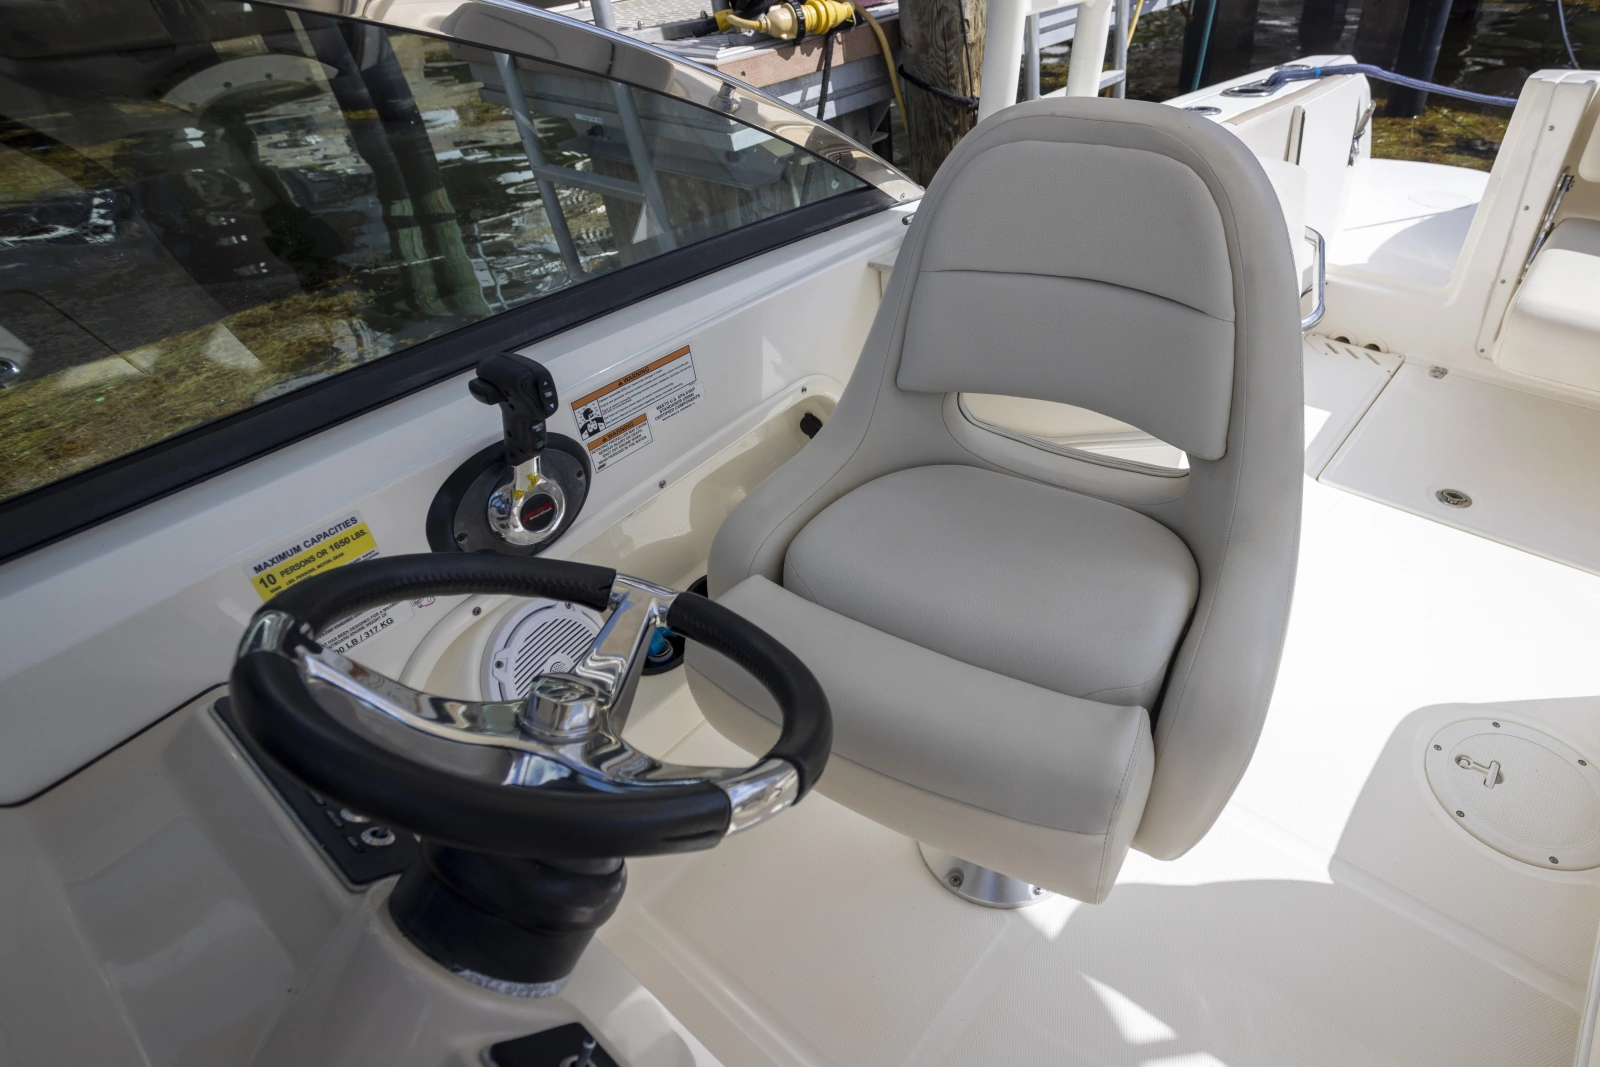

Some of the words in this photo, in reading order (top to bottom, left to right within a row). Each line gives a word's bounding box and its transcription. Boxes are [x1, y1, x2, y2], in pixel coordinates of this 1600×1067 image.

[623, 366, 650, 383] WARNING
[608, 421, 634, 439] WARNING
[608, 448, 624, 459] PERSONS
[253, 545, 302, 574] MAXIMUM
[303, 516, 358, 549] CAPACITIES
[259, 574, 277, 589] 10
[280, 555, 316, 578] PERSONS
[316, 548, 328, 559] OR
[329, 536, 351, 552] 1650
[350, 528, 368, 541] LBS.
[334, 646, 344, 656] 00
[346, 638, 358, 649] LB
[364, 626, 379, 638] 317
[380, 617, 394, 629] KG
